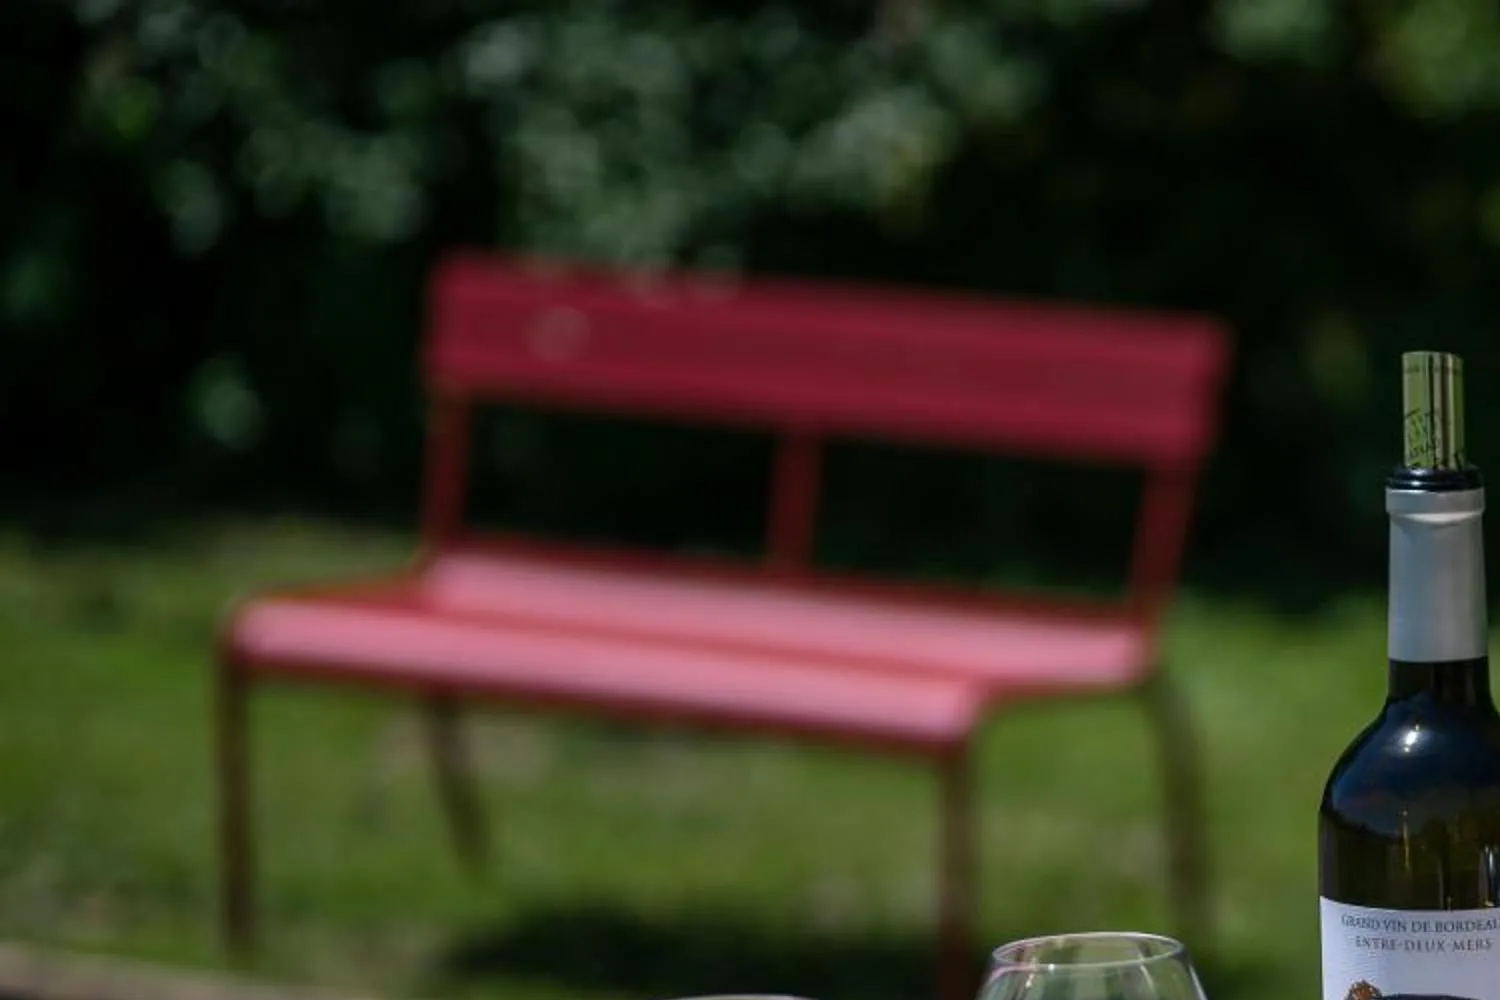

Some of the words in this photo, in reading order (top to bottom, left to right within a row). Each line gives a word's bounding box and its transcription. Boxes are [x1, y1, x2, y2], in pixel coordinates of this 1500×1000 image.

[1341, 913, 1380, 930] GRAND
[1384, 919, 1408, 933] VIN
[1412, 920, 1430, 933] DE
